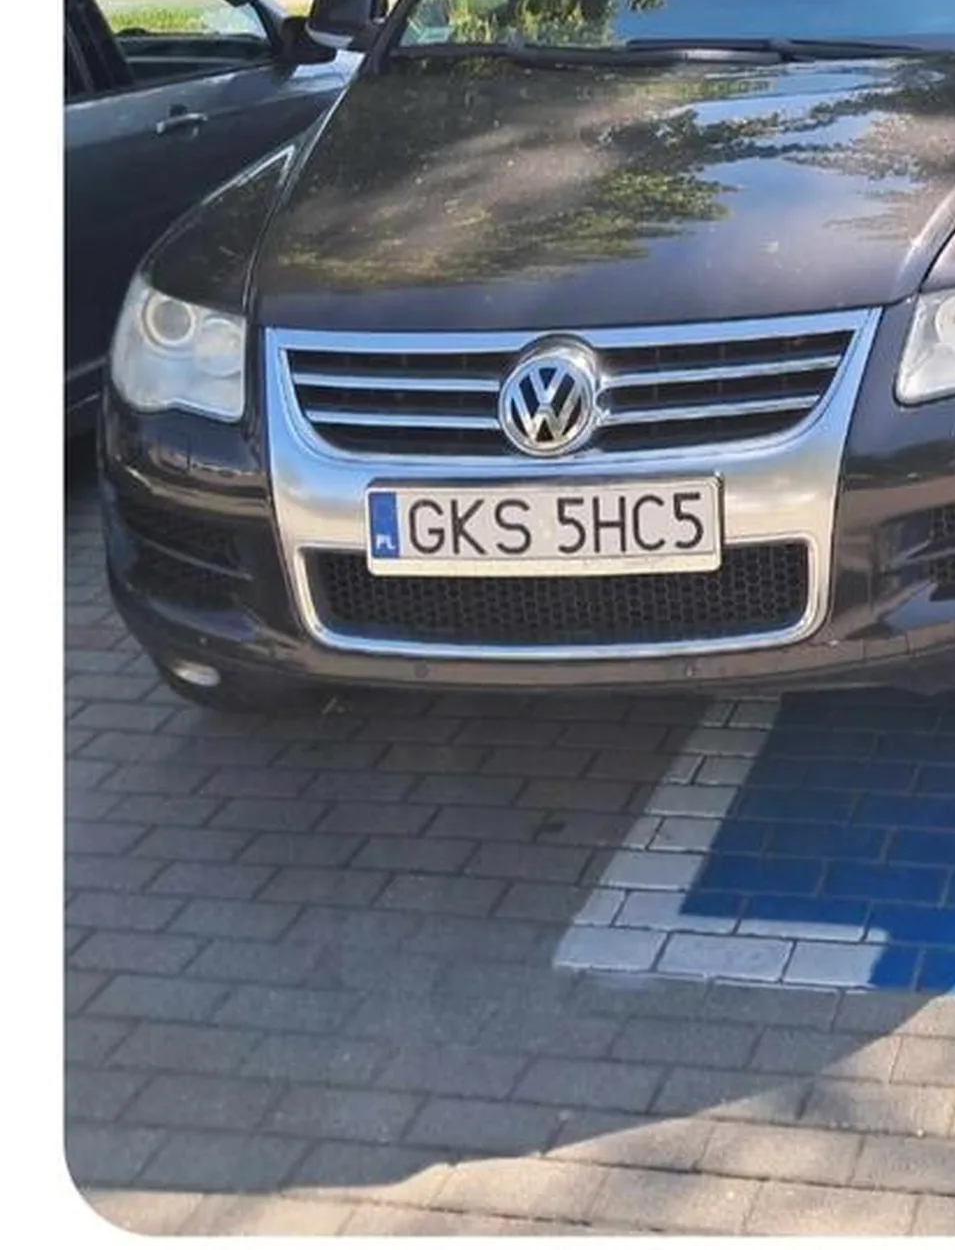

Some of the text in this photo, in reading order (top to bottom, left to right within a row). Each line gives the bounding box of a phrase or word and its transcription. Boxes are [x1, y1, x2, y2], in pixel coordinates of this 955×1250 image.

[375, 492, 705, 555] PL GKS 5HC5
